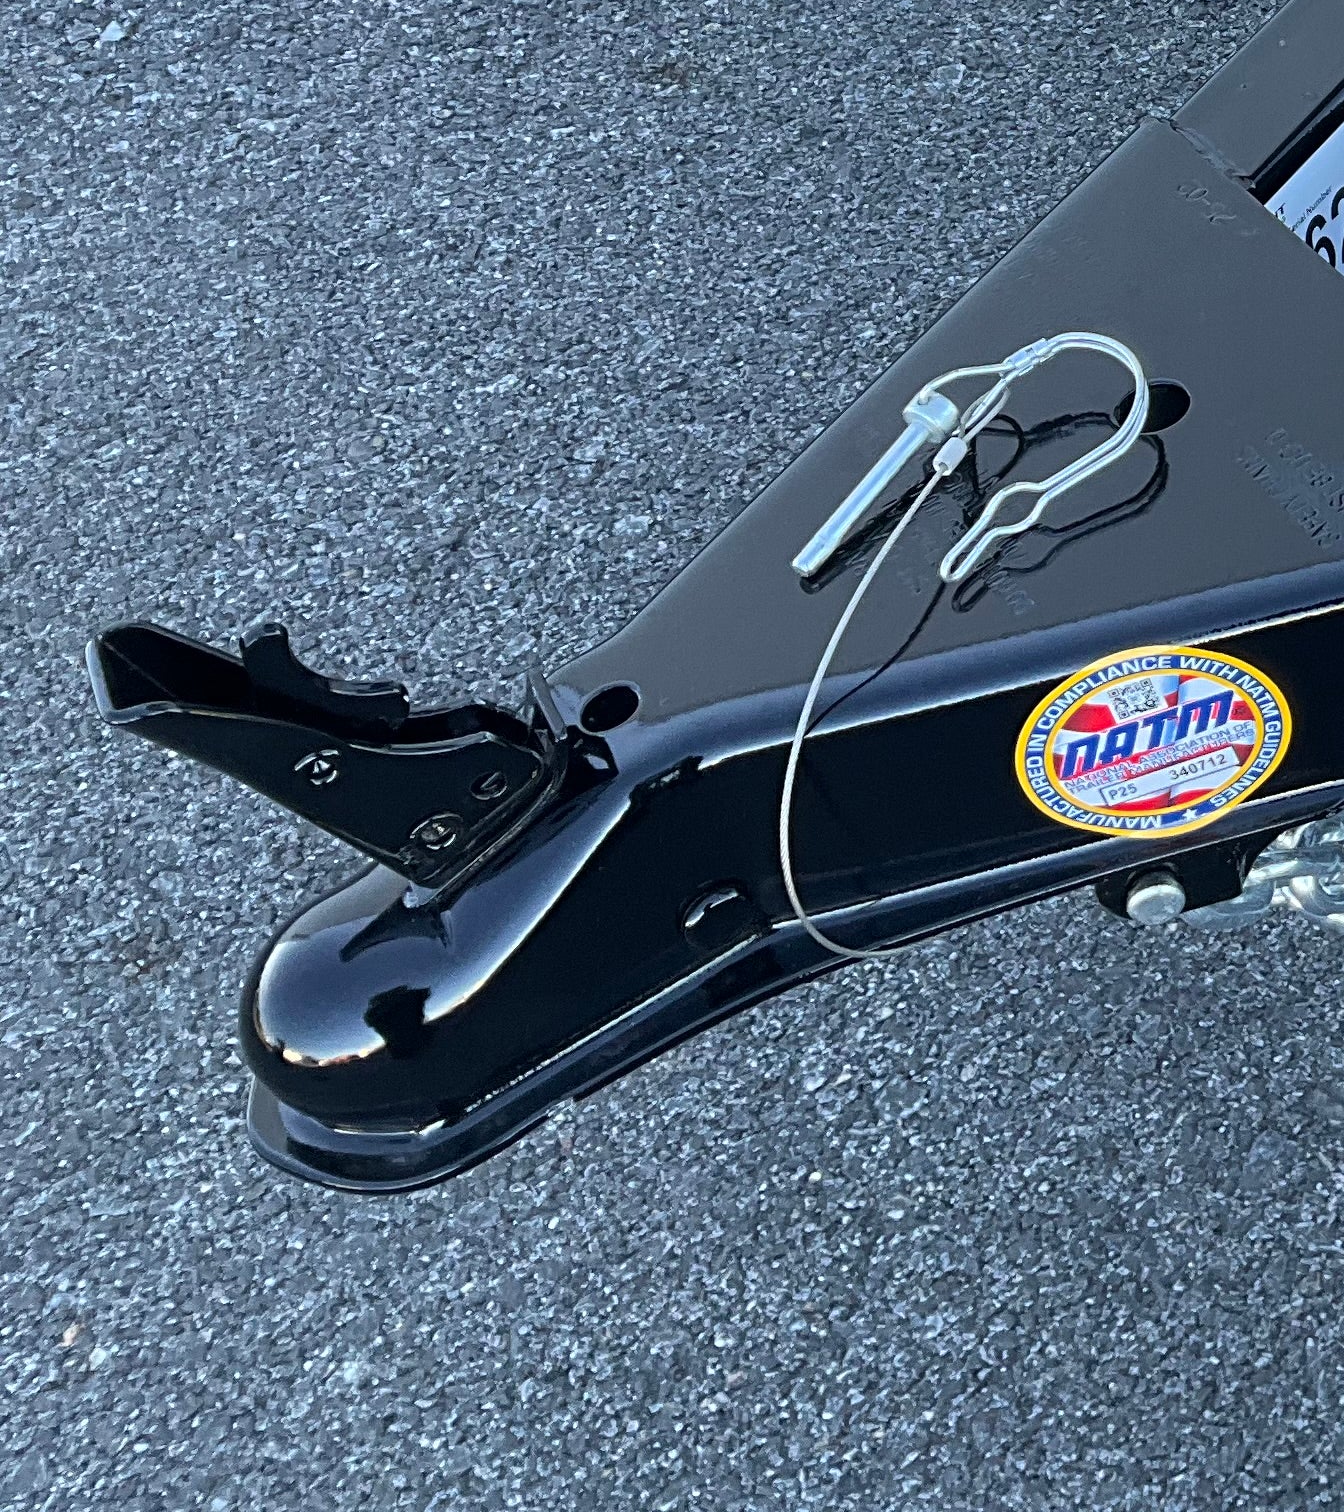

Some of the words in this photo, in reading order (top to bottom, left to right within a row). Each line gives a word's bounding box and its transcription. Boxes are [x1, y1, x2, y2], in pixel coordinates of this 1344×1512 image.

[1039, 656, 1171, 729] COMPLIANCE
[1180, 656, 1233, 681] WITH
[1237, 674, 1279, 717] NATM
[1026, 737, 1045, 756] IN
[1064, 760, 1135, 788] NATIONAL
[1140, 727, 1232, 764] ASSOCIATION
[1234, 721, 1254, 736] OF
[1068, 770, 1124, 795] TRAILER
[1126, 729, 1255, 779] MANUFACTURERS
[1108, 784, 1137, 800] P25
[1169, 753, 1228, 781] 340712
[1210, 721, 1282, 807] GUIDELINES
[1026, 759, 1162, 830] MANUFACTURED
